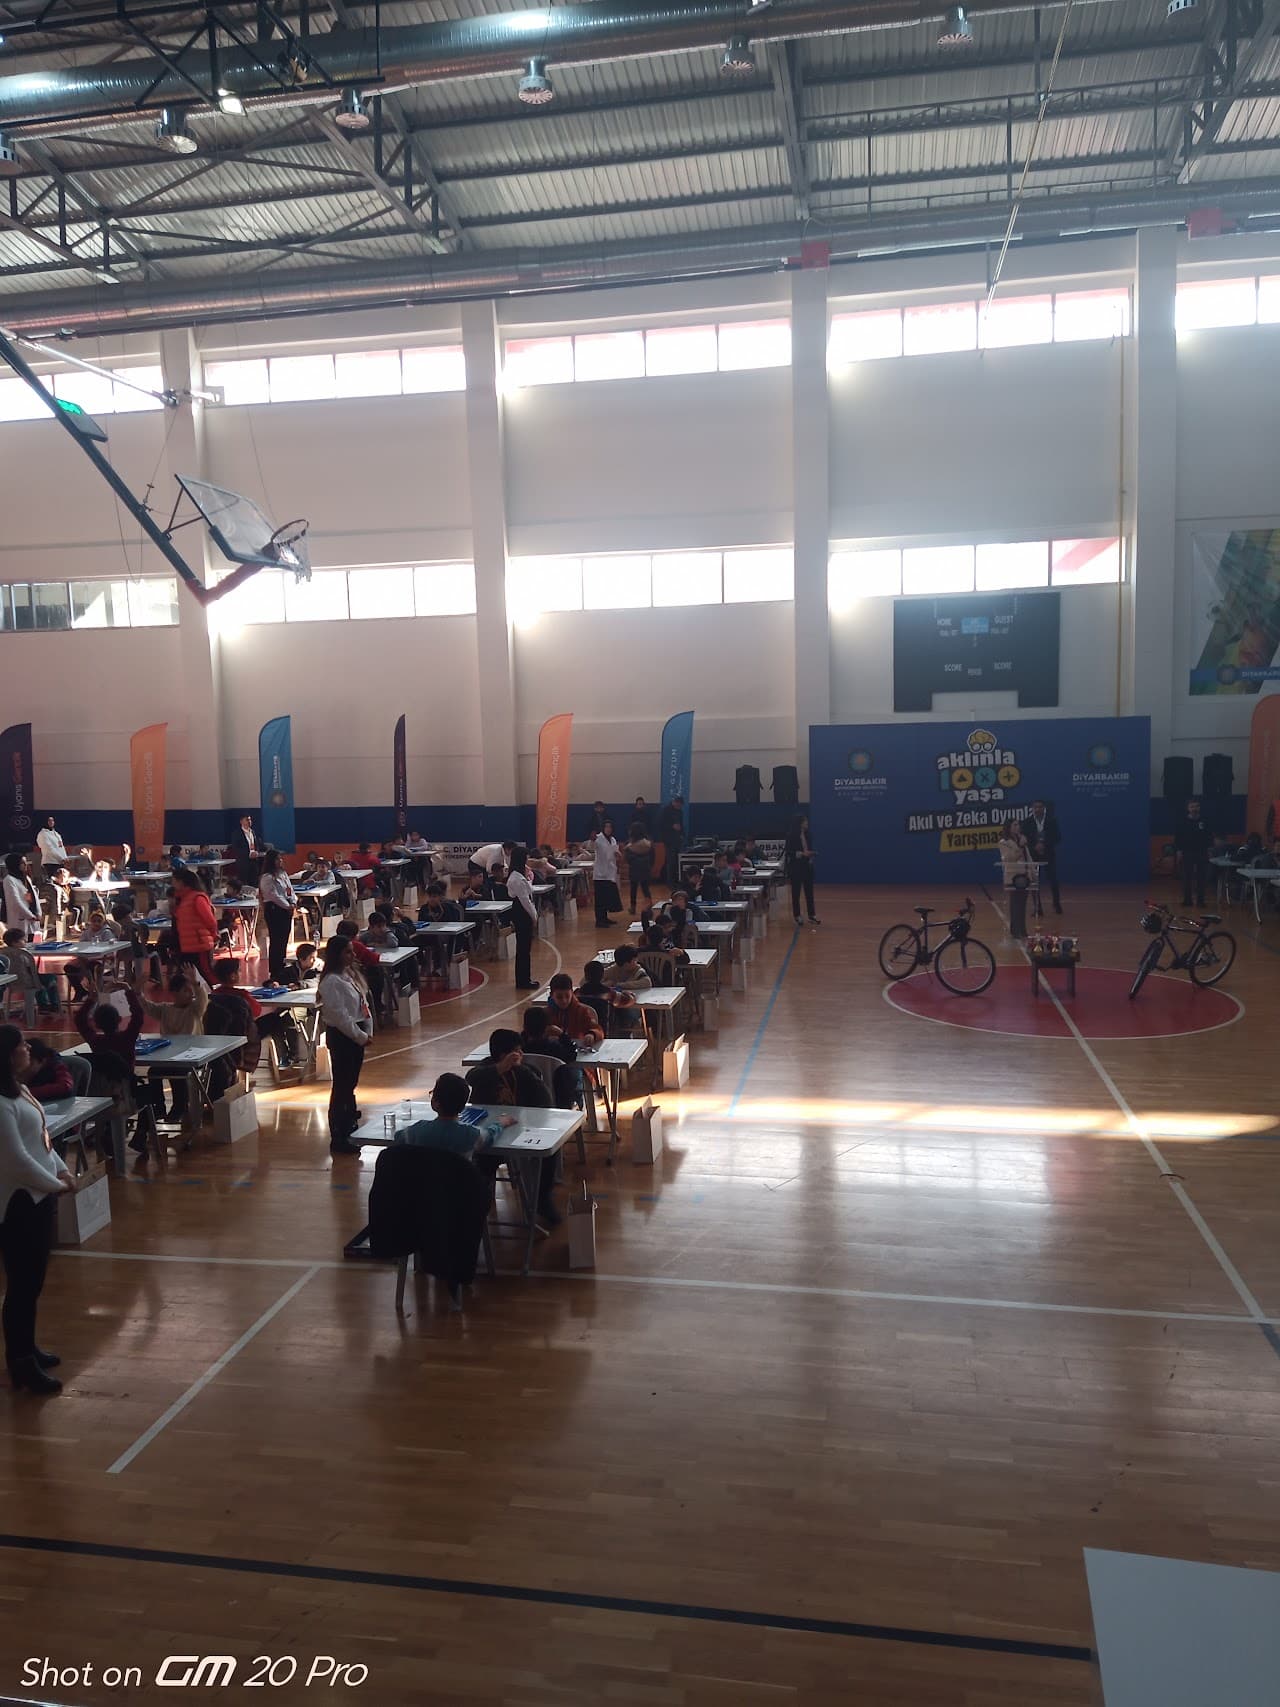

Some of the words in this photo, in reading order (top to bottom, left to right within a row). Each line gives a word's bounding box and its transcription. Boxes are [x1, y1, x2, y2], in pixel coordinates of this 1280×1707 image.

[937, 750, 1015, 769] aklınla
[954, 788, 1004, 805] yaşa
[908, 814, 933, 831] Akıl
[937, 816, 952, 828] ve
[956, 811, 988, 827] Zeka
[992, 806, 1033, 824] Oyunla
